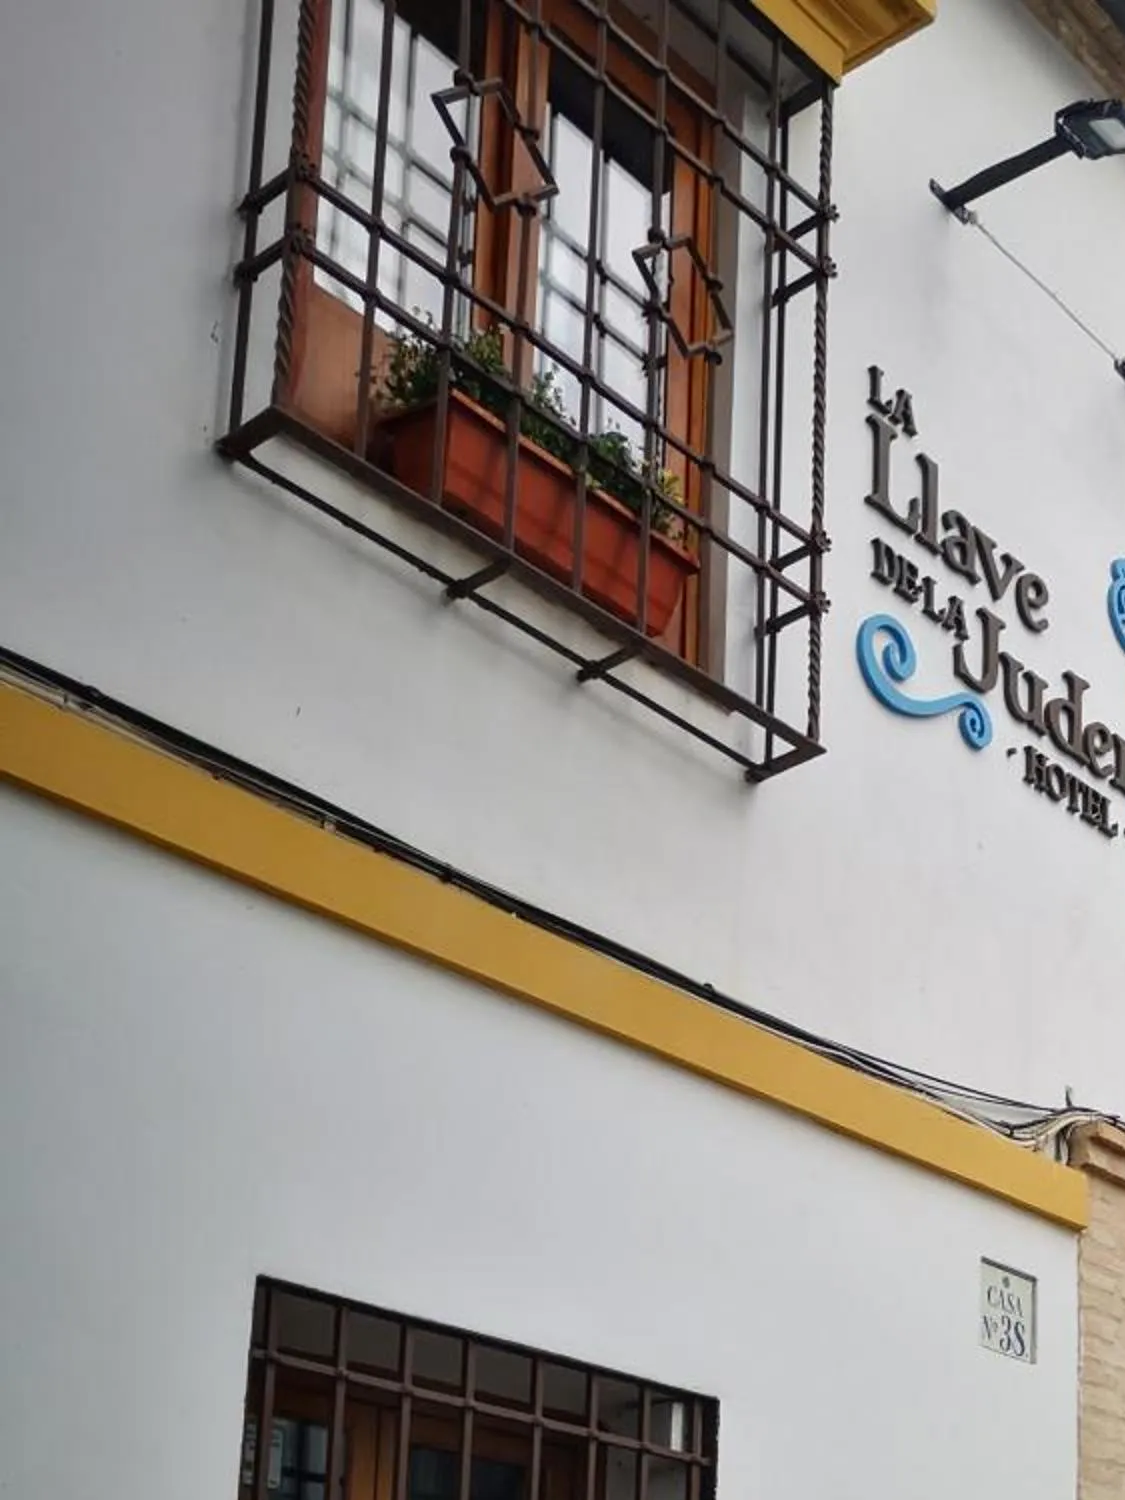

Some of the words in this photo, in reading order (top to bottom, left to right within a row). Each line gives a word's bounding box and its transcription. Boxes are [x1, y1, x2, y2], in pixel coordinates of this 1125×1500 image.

[866, 365, 918, 438] LA
[864, 413, 1049, 634] Llave
[871, 537, 921, 604] DE
[921, 576, 970, 641] LA
[1023, 745, 1119, 839] HOTEL
